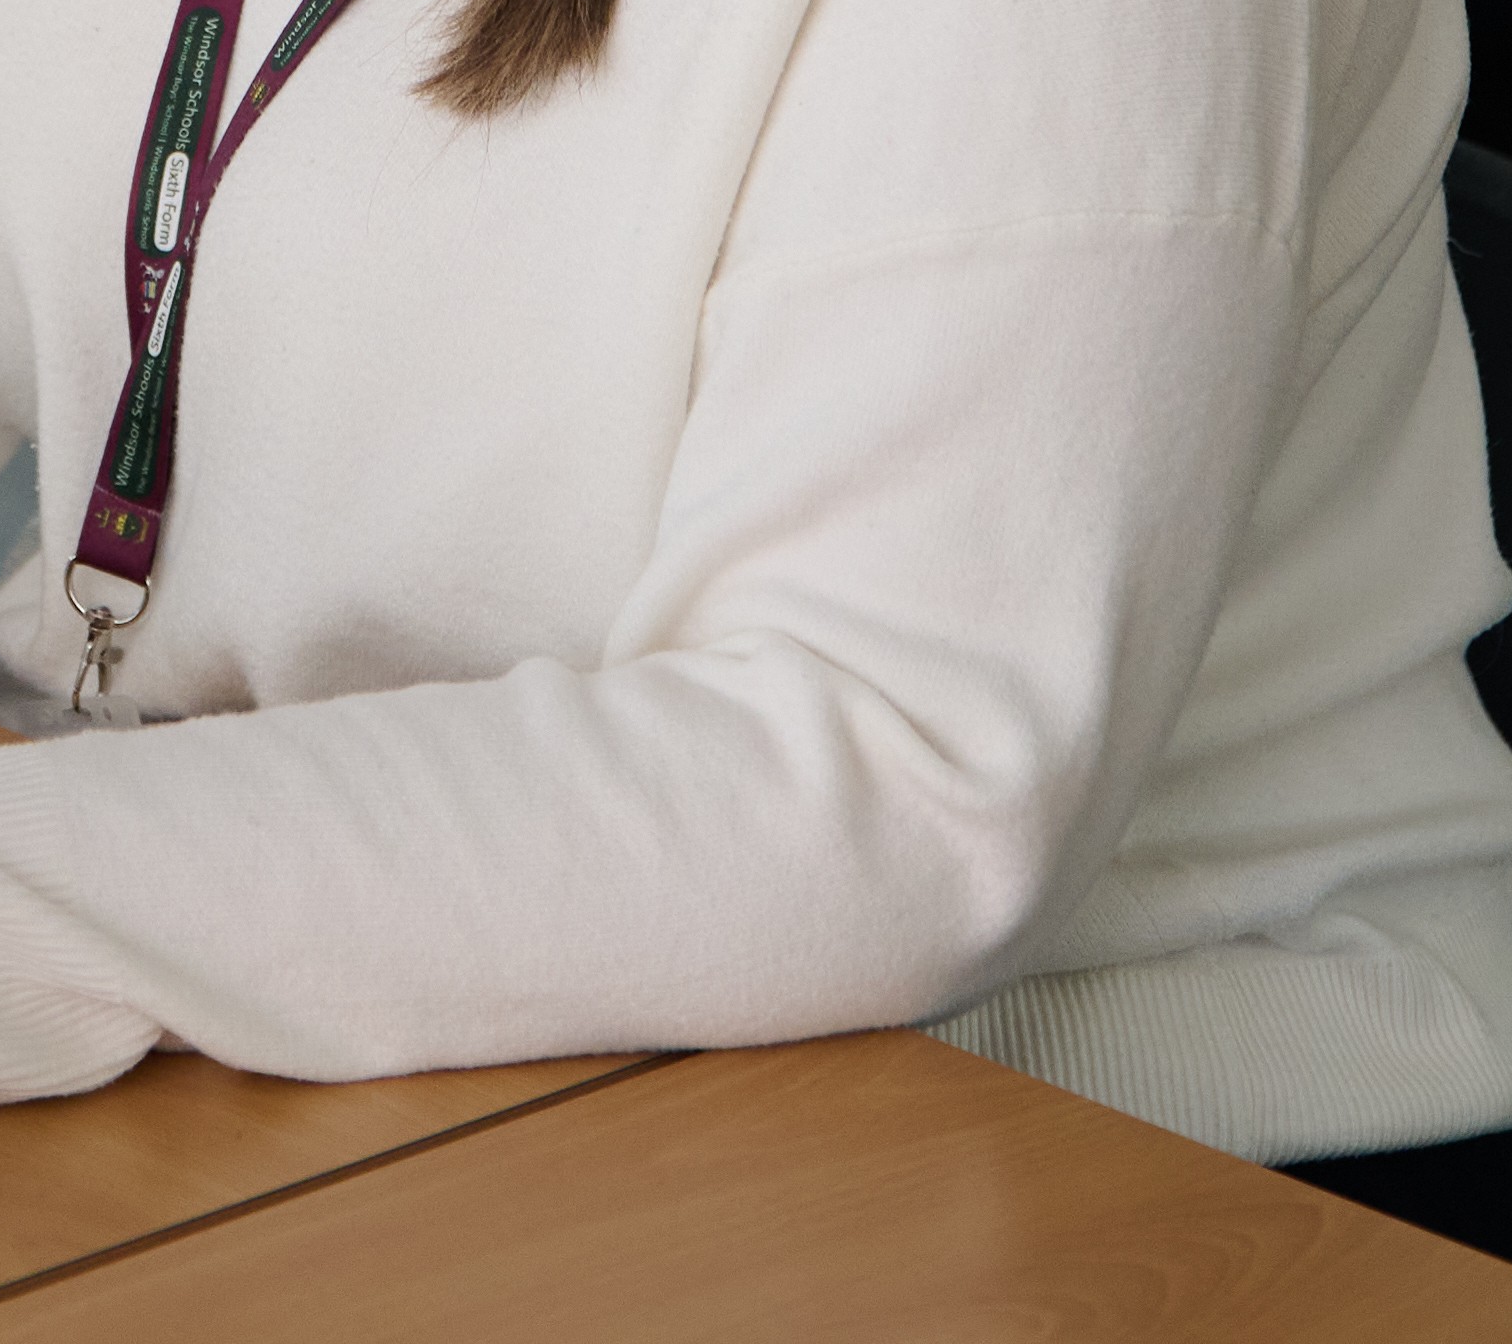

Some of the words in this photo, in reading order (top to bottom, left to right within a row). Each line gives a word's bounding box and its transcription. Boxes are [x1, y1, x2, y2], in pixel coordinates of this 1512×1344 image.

[187, 16, 196, 33] The
[274, 1, 317, 58] Windsor
[177, 36, 191, 74] Windsor
[192, 18, 219, 86] Windsor
[160, 104, 174, 136] School
[176, 90, 202, 150] Schools
[148, 146, 163, 186] Windsor
[165, 159, 184, 197] Sixth
[137, 216, 153, 250] School
[159, 204, 176, 245] Form
[115, 423, 139, 486] Windsor
[132, 358, 155, 417] Schools
[150, 312, 166, 351] Sixth
[162, 267, 180, 310] Form
